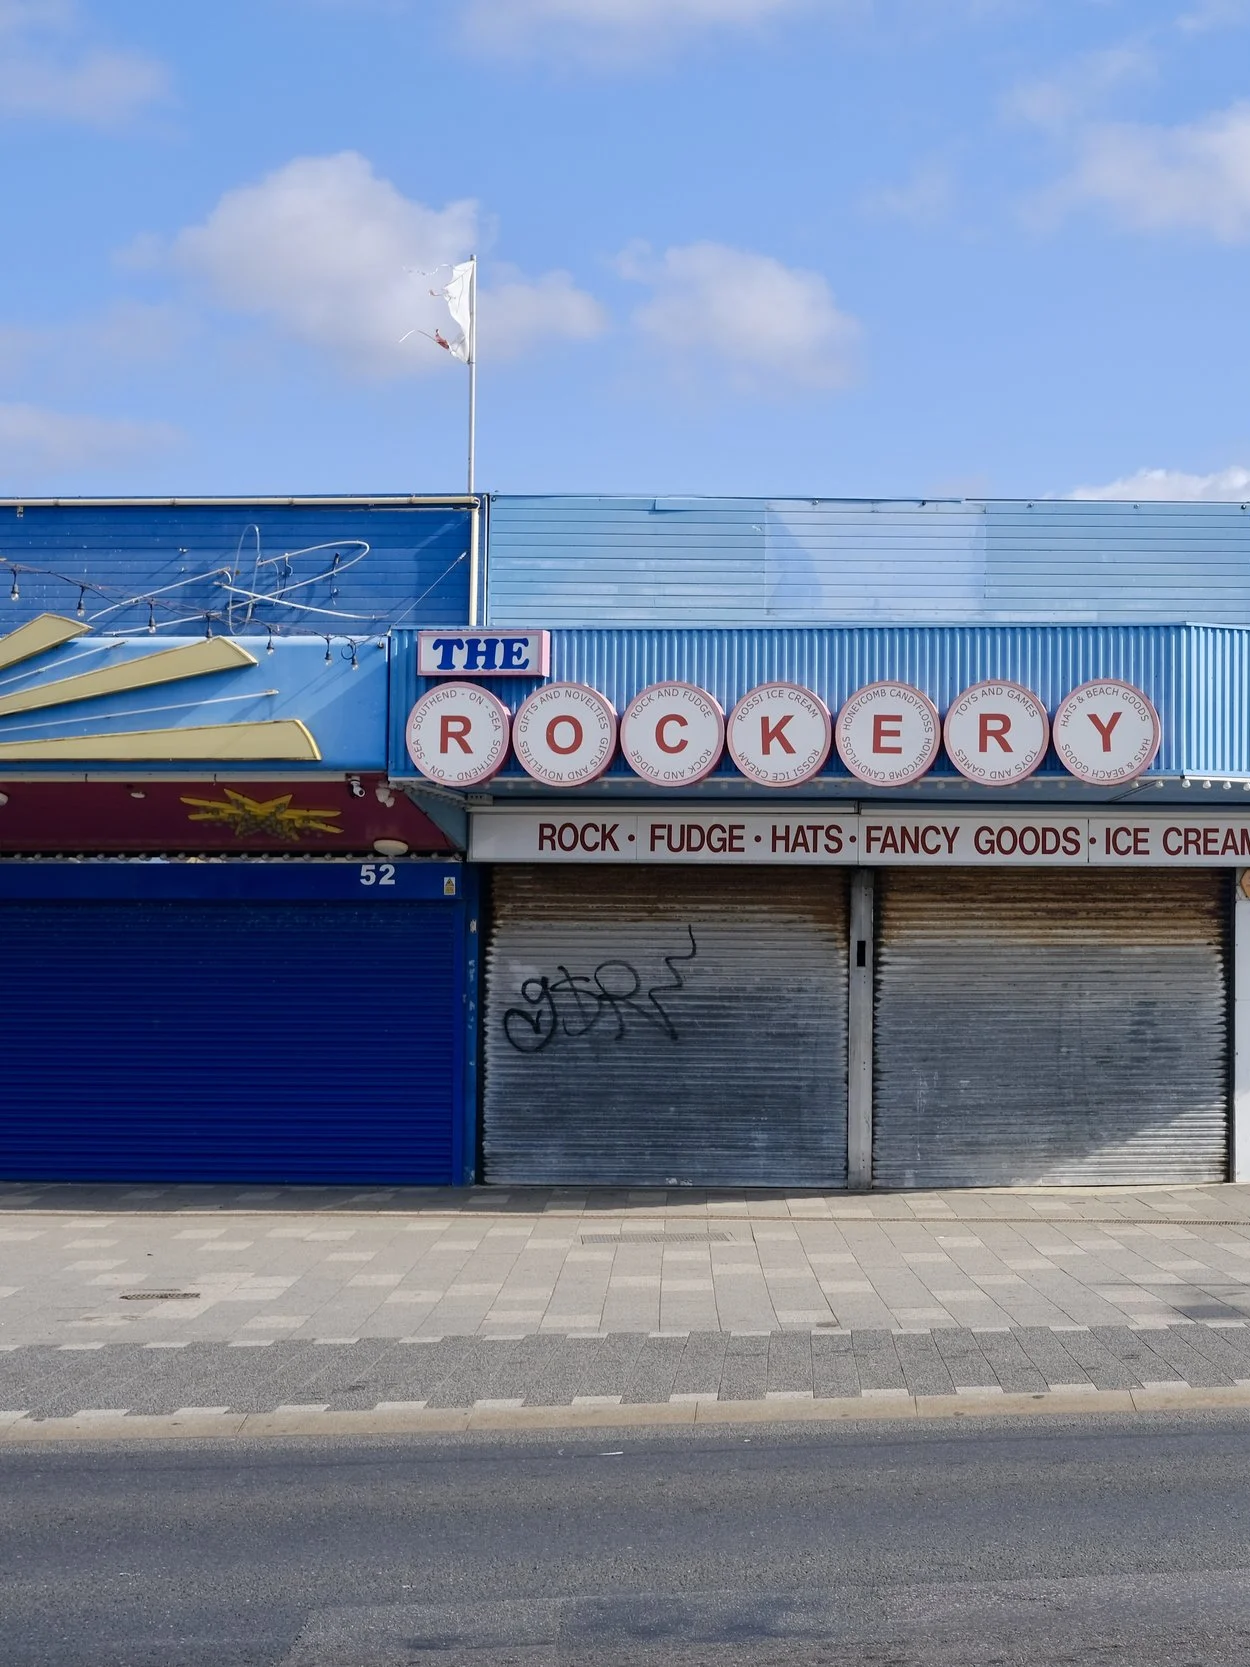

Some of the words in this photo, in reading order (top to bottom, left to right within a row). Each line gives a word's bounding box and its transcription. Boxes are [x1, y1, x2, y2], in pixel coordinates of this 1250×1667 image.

[432, 637, 530, 671] THE
[413, 689, 457, 731] SOUTHEND
[469, 693, 484, 705] ON
[488, 710, 501, 732] SEA
[520, 703, 539, 733] GIFTS
[539, 690, 561, 705] AND
[565, 690, 609, 730] NOVELTIES
[631, 694, 655, 720] ROCK
[657, 689, 679, 698] AND
[682, 691, 713, 718] FUDGE
[737, 694, 763, 722] ROSSI
[767, 690, 784, 699] ICE
[788, 691, 819, 719] CREAM
[843, 689, 887, 731] HONEYCOMB
[889, 689, 933, 733] CANDYFLOSS
[955, 694, 978, 717] TOYS
[981, 688, 1004, 698] AND
[1007, 689, 1038, 718] GAMES
[1061, 702, 1077, 727] HATS
[1085, 687, 1119, 699] BEACH
[1122, 692, 1150, 722] GOODS
[412, 739, 426, 760] SEA
[457, 739, 501, 781] SOUTHEND
[520, 740, 563, 781] NOVELTIES
[589, 737, 609, 767] GIFTS
[630, 750, 659, 777] FUDGE
[687, 749, 712, 774] ROCK
[793, 749, 820, 776] ROSSI
[843, 736, 886, 779] CANDYFLOSS
[889, 738, 933, 779] HONEYCOMB
[955, 749, 986, 777] GAMES
[1015, 750, 1038, 773] TOYS
[1061, 744, 1089, 774] GOODS
[1134, 738, 1151, 763] HATS
[430, 764, 445, 779] ON
[568, 765, 589, 780] AND
[663, 770, 685, 780] AND
[739, 751, 768, 779] CREAM
[772, 771, 790, 781] ICE
[990, 770, 1012, 780] AND
[1092, 767, 1125, 779] BEACH
[539, 823, 620, 852] ROCK
[649, 824, 745, 853] FUDGE
[771, 824, 843, 854] HATS
[866, 825, 960, 855] FANCY
[974, 825, 1081, 856] GOODS
[1105, 827, 1150, 856] ICE
[360, 864, 395, 885] 52
